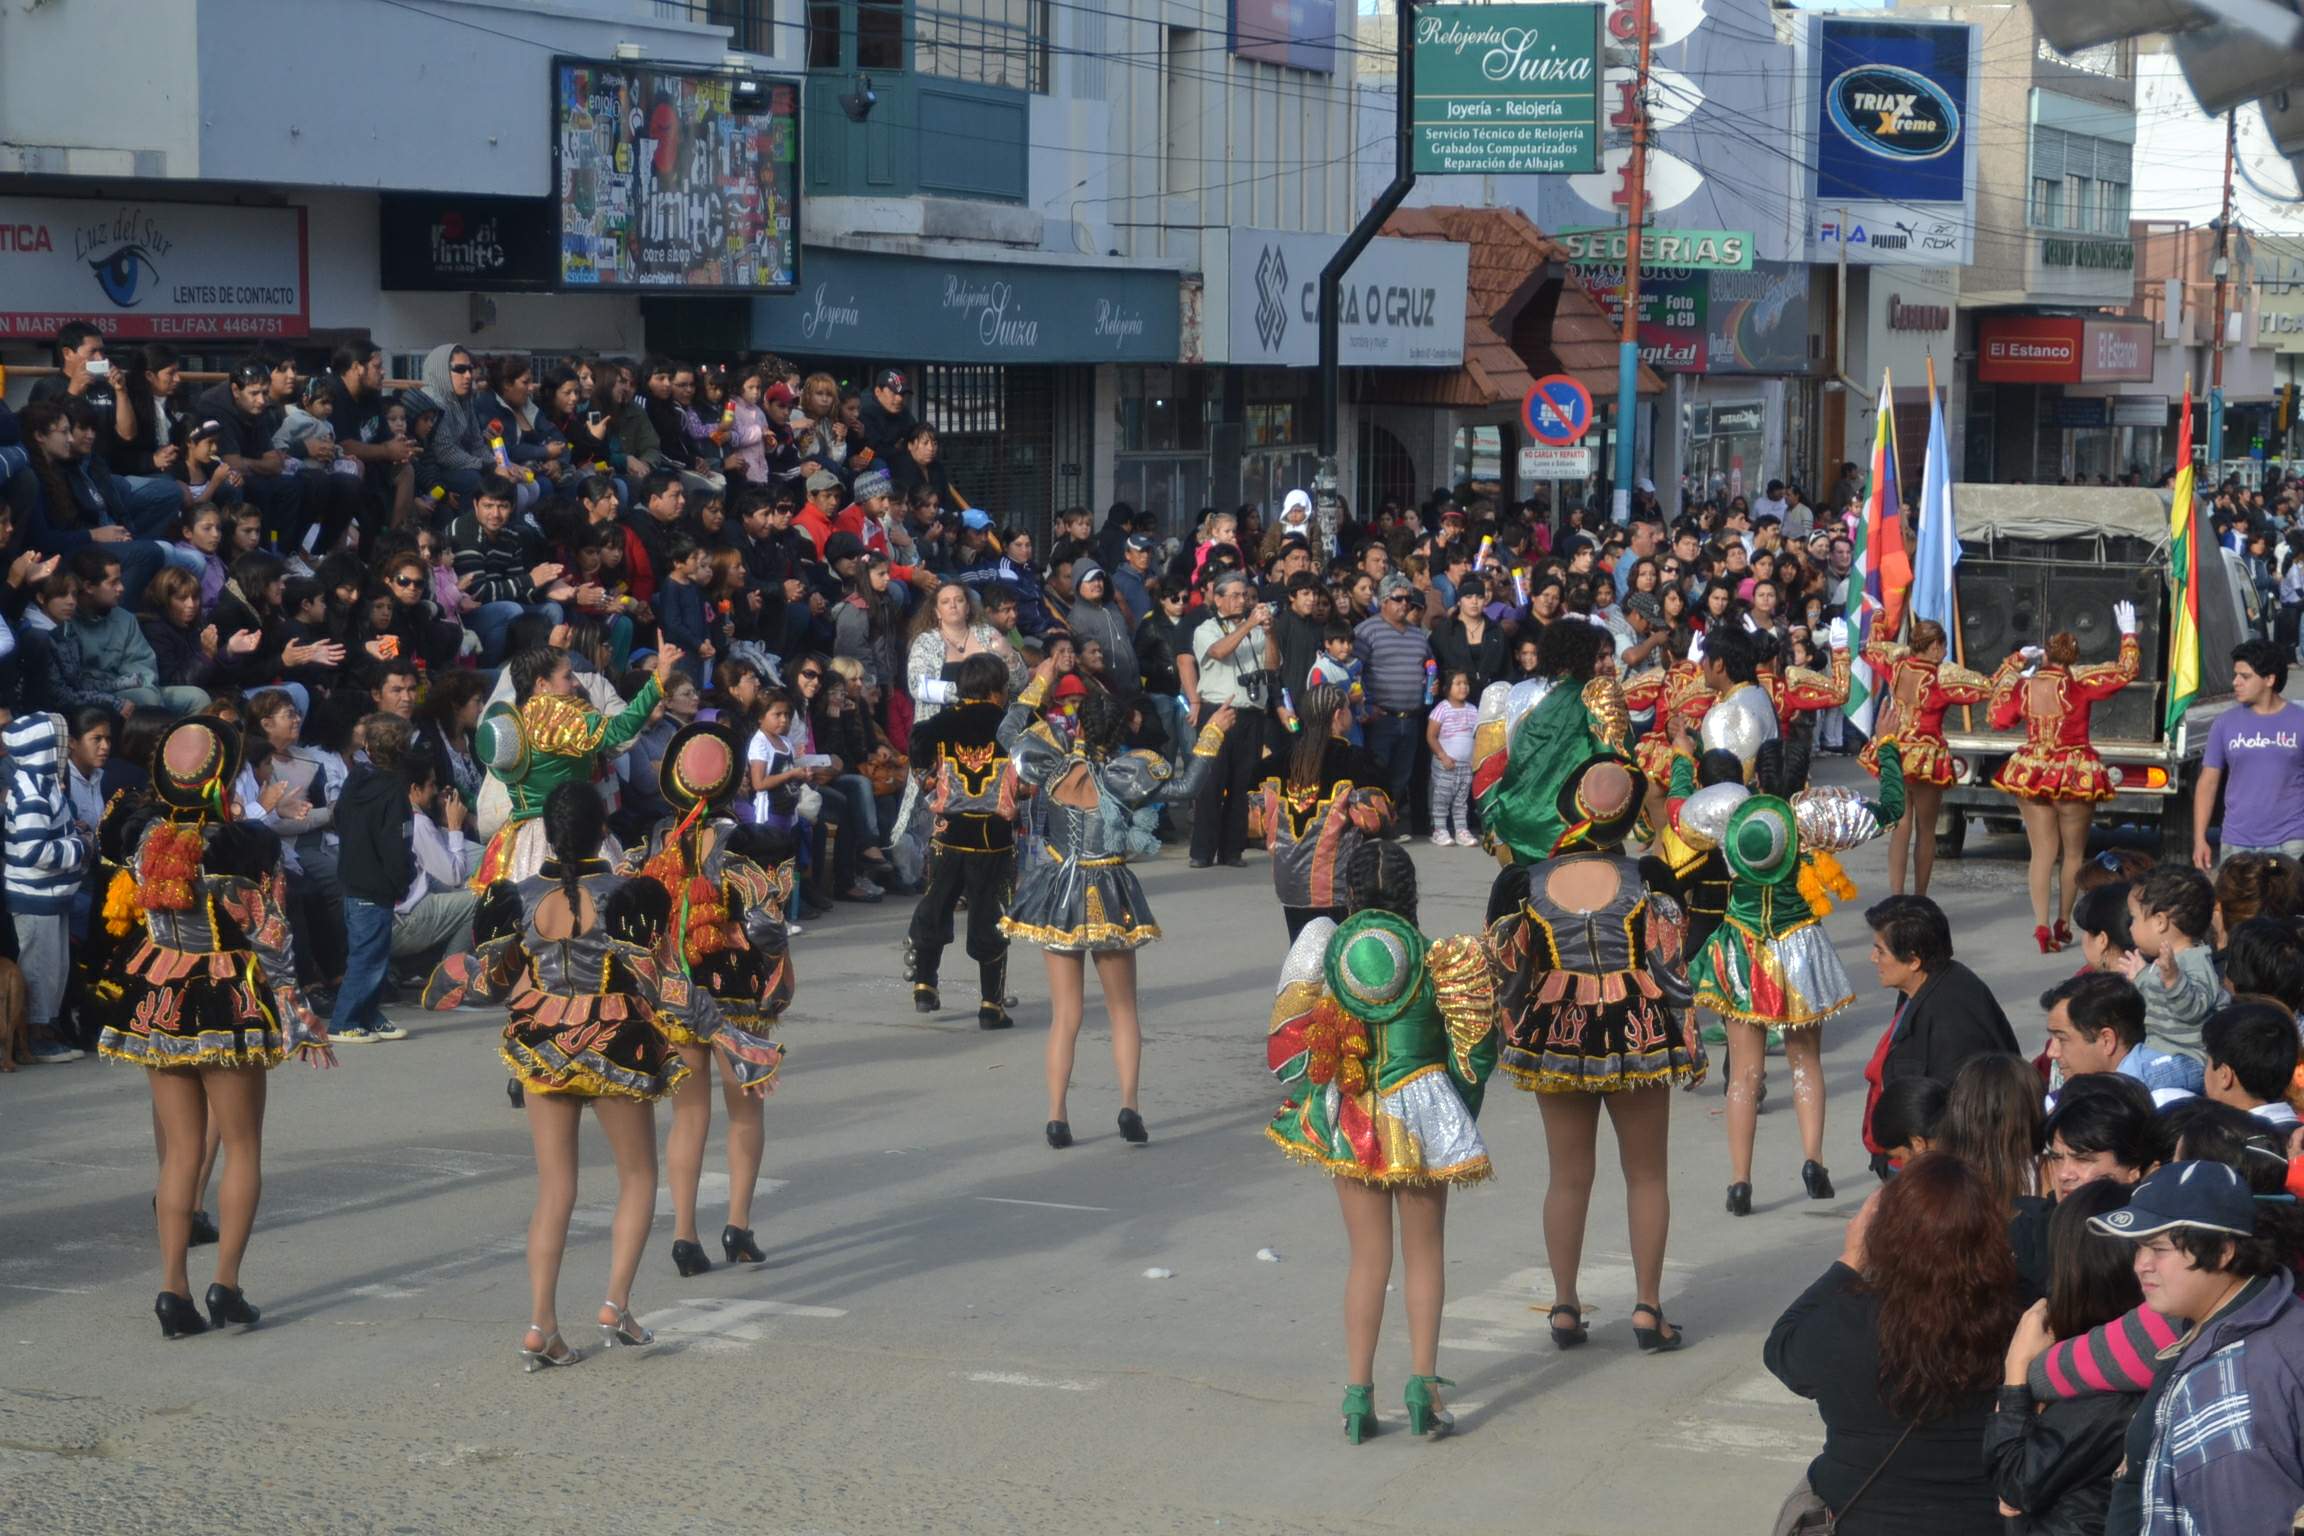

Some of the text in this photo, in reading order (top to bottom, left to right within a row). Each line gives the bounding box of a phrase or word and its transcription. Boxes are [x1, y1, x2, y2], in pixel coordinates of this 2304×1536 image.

[1482, 27, 1591, 81] Suiza
[1447, 100, 1492, 119] Joyería
[1506, 100, 1563, 119] Relojería
[1853, 93, 1917, 117] TRIAX
[1425, 127, 1584, 143] Servicio Técnico de Relojería
[1431, 142, 1577, 156] Grabados Computarizados
[1444, 157, 1564, 172] Reparación de Alhajas
[75, 207, 173, 261] Luz del Sur
[1871, 234, 1908, 250] PUMA
[1566, 234, 1744, 265] SEDERIAS
[173, 286, 294, 305] LENTES DE CONTACTO
[1301, 282, 1436, 328] CRA O CRUZ
[1666, 295, 1694, 310] Foto
[802, 281, 860, 340] Joyería
[943, 274, 1039, 347] Relojería Suiza
[1666, 312, 1696, 327] a CD
[152, 317, 283, 333] TEL/FAX 4464751
[1095, 298, 1144, 349] Relojería
[1990, 343, 2070, 359] El Estanco
